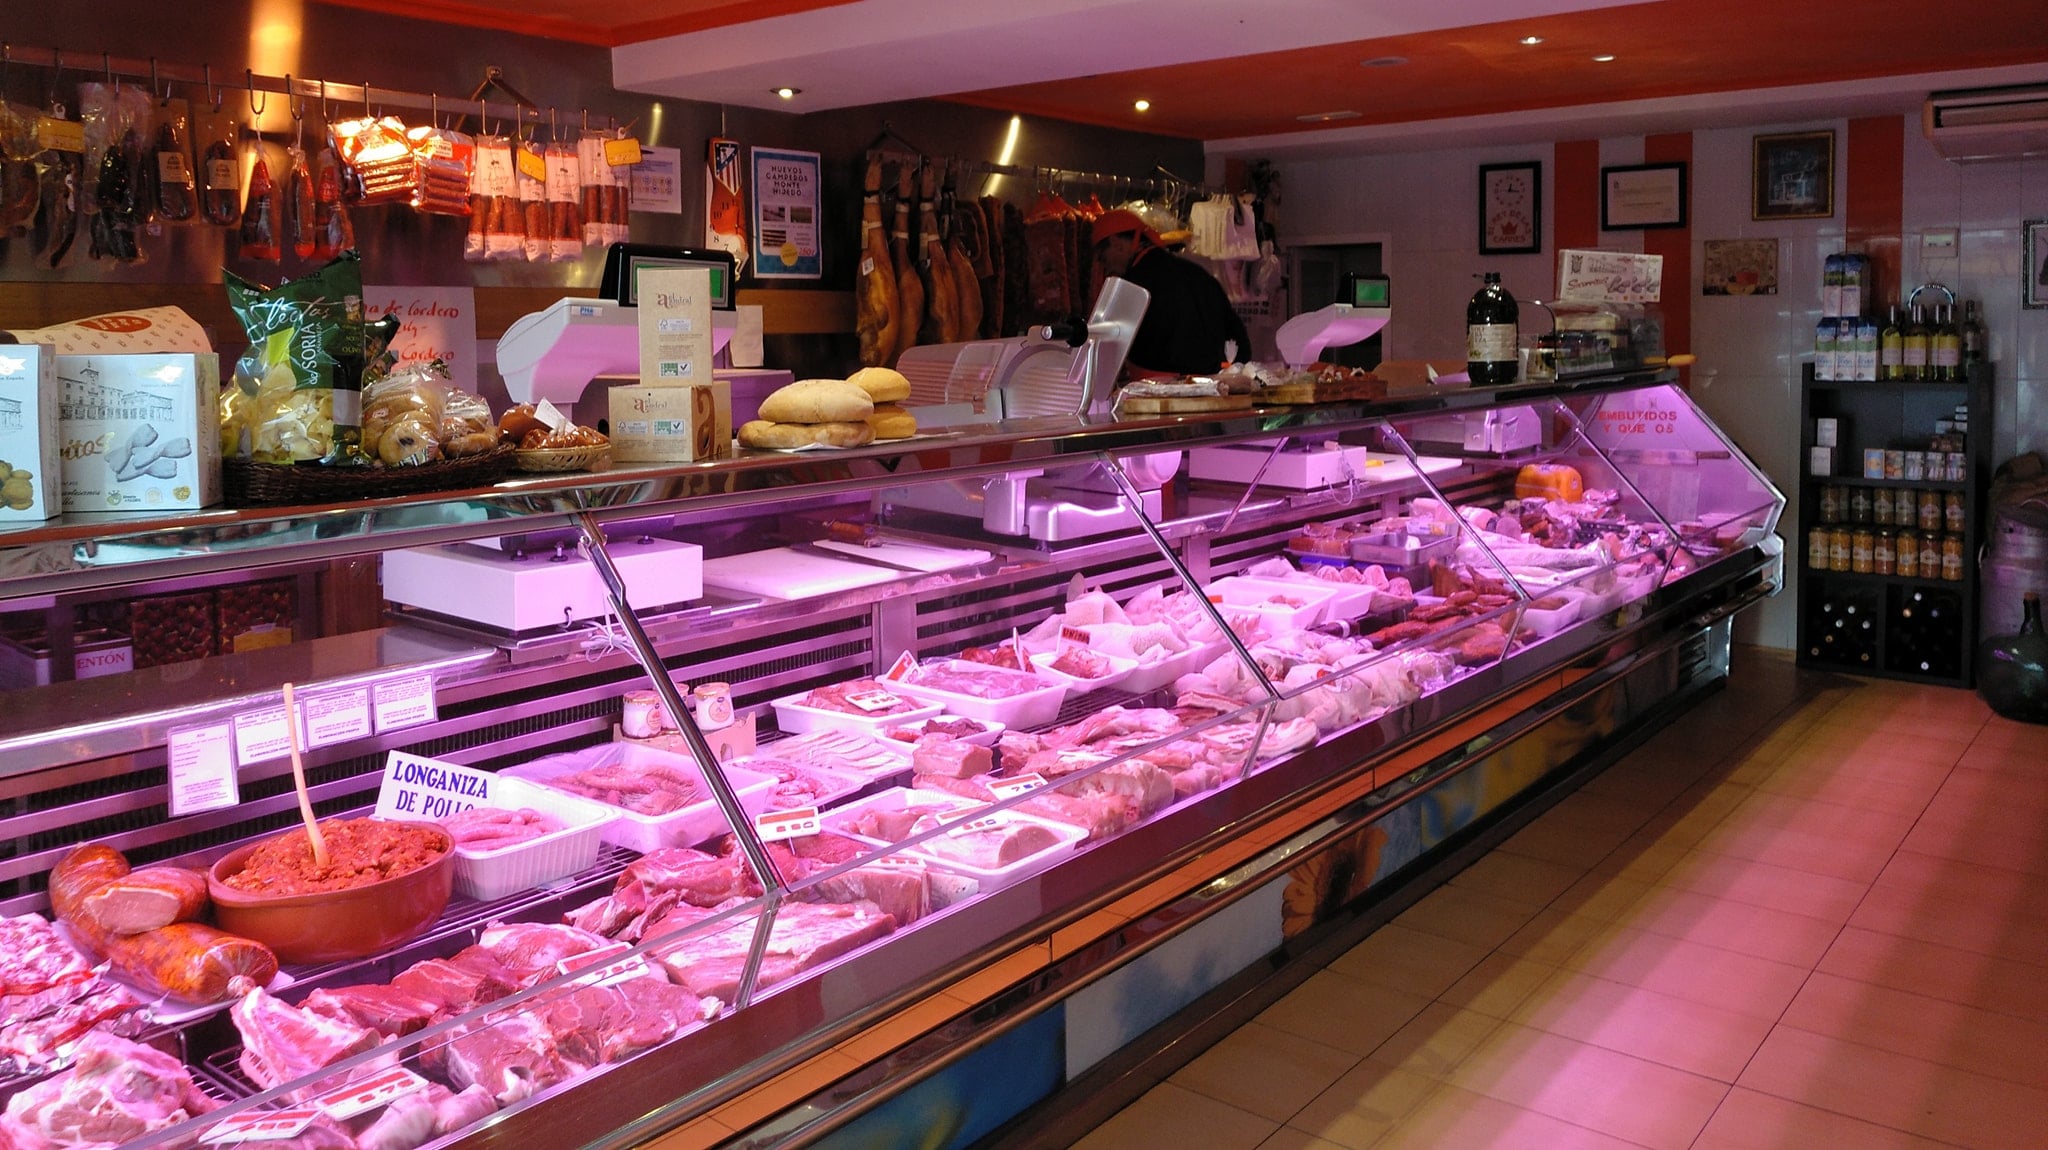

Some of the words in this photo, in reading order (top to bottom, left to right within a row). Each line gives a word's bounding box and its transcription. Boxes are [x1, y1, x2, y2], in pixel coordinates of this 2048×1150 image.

[774, 181, 800, 189] MONTE
[301, 322, 318, 369] SORIA
[1598, 410, 1677, 421] EMBUTIDOS
[1603, 423, 1611, 433] Y
[392, 760, 488, 799] LONGANIZA
[395, 789, 418, 812] DE
